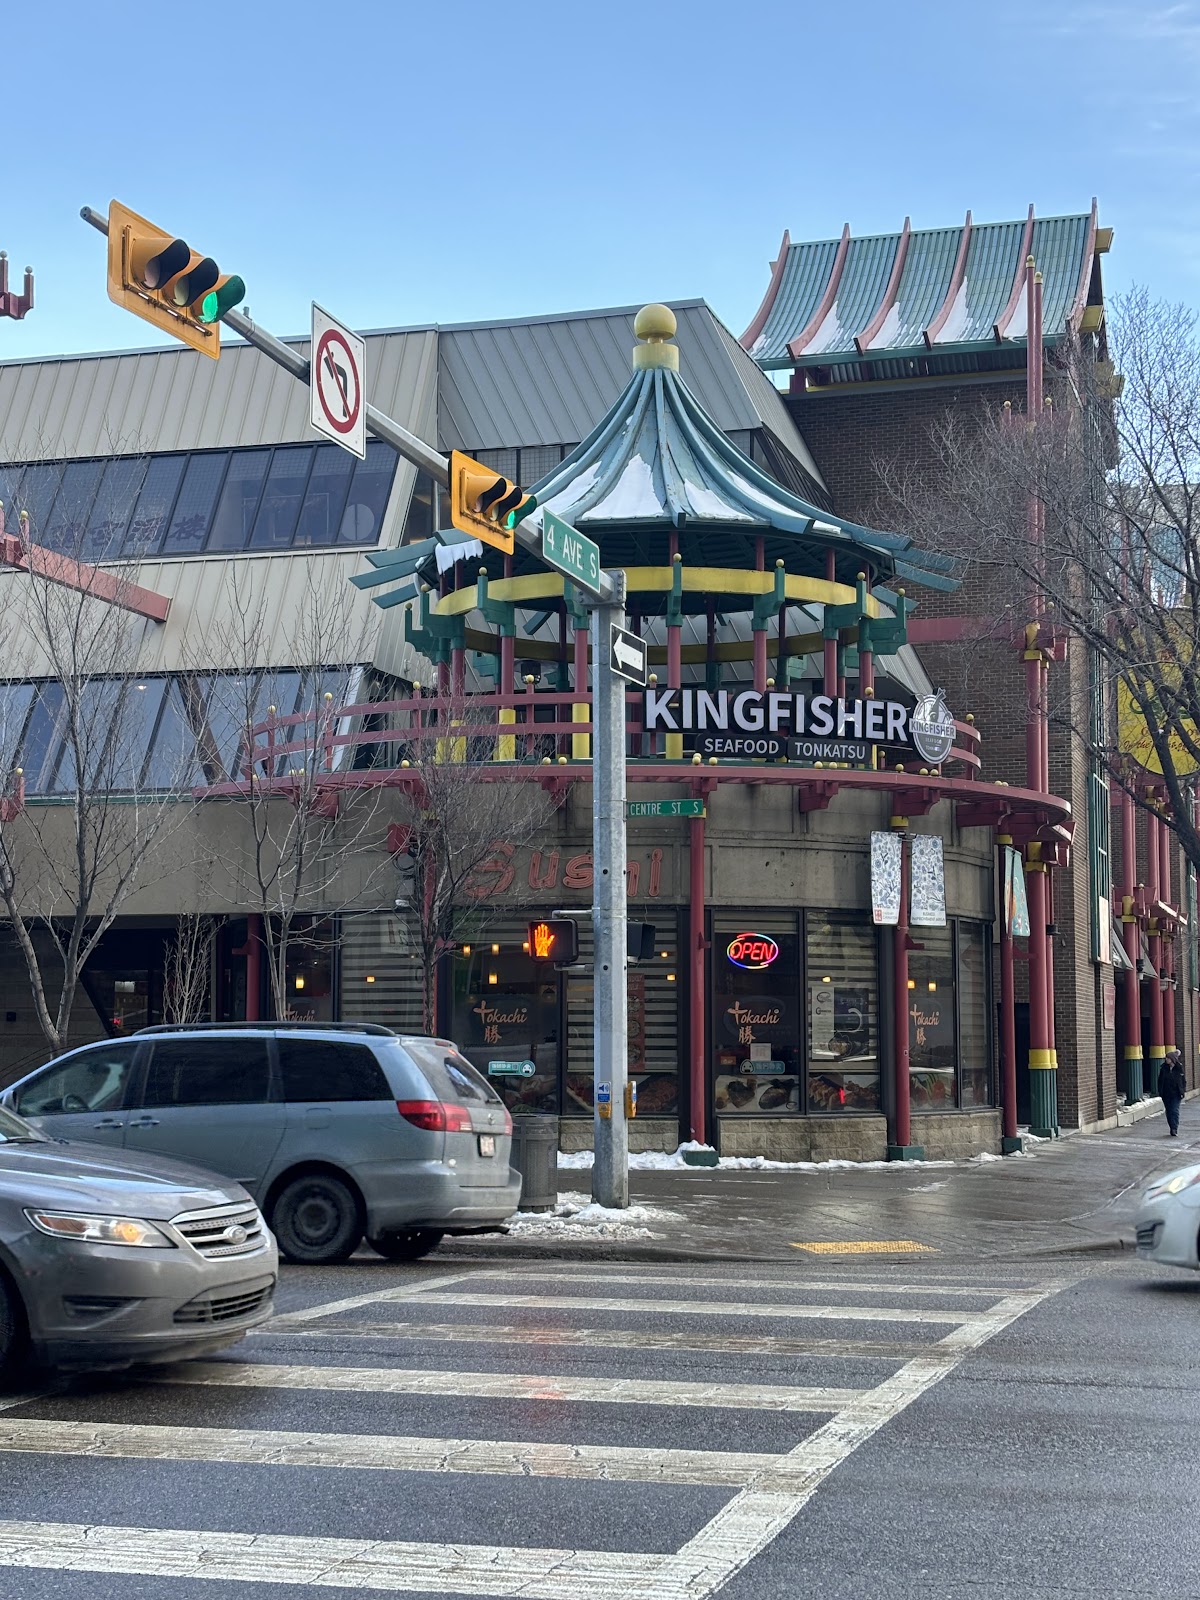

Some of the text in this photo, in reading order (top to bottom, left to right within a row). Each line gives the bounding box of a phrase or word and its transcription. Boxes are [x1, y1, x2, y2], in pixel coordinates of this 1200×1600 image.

[546, 524, 597, 578] 4 AVE S
[646, 690, 908, 742] KINGFISHER
[911, 720, 955, 737] KINGFISHER
[704, 738, 779, 754] SEAFOOD
[795, 742, 866, 760] TONKATSU
[630, 801, 699, 815] CENTRE ST S
[730, 942, 774, 960] OPEN
